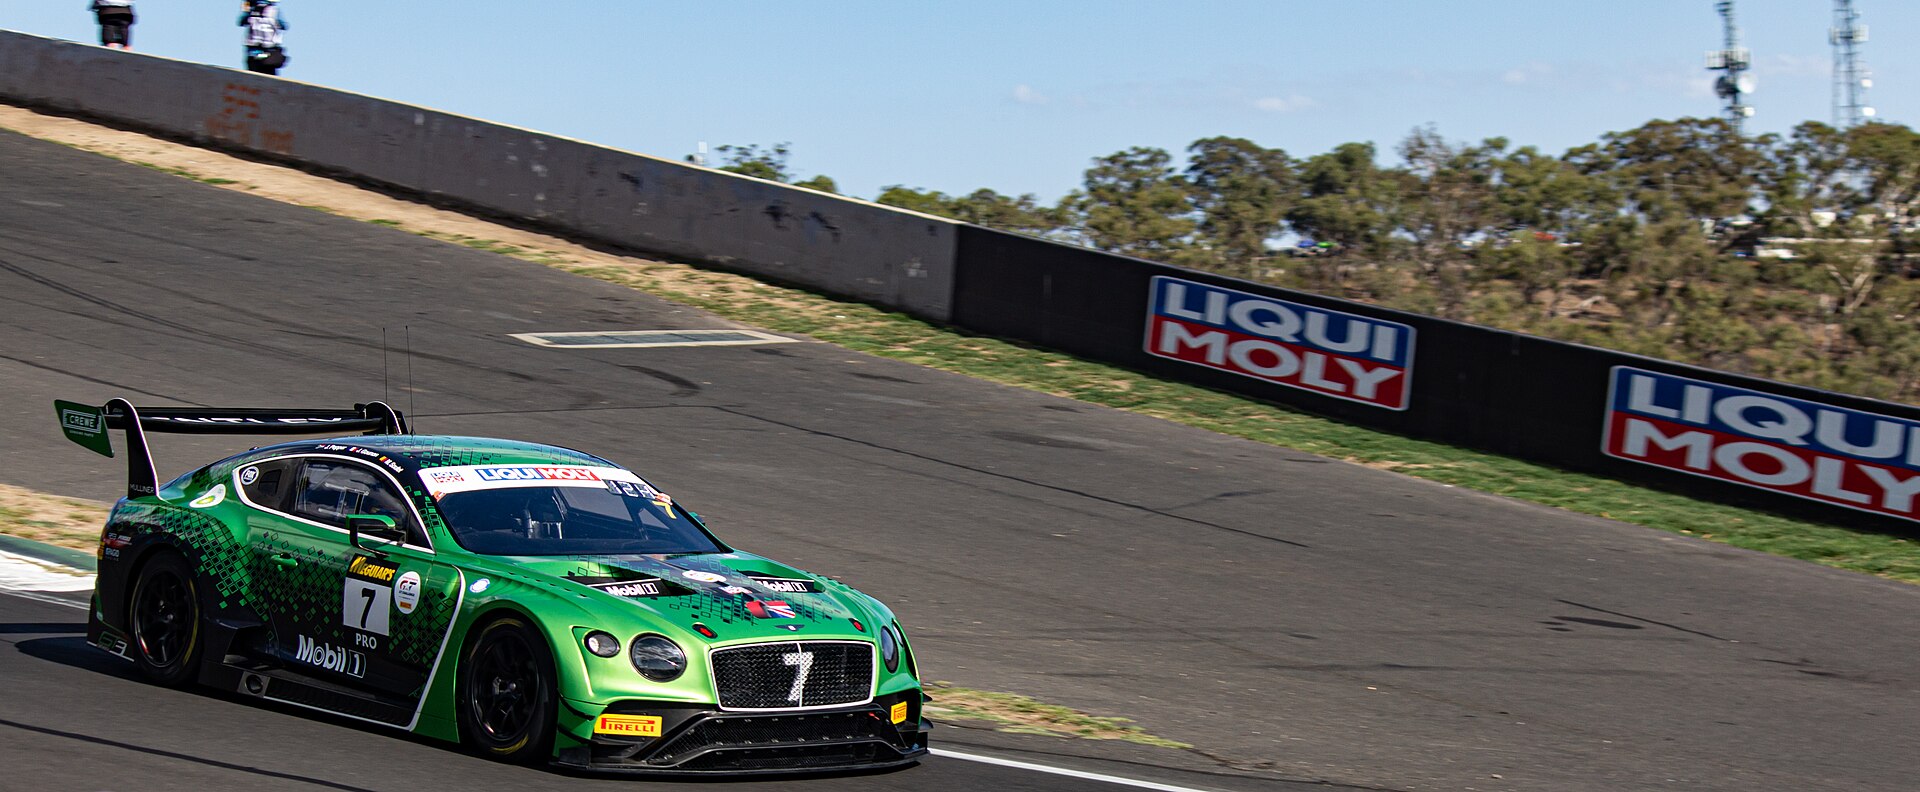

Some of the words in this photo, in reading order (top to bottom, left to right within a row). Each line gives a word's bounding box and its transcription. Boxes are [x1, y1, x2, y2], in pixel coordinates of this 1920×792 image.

[1163, 282, 1398, 361] LIQUI
[1159, 321, 1405, 399] MOLY
[70, 415, 95, 428] CREWE
[478, 468, 543, 480] LIQUI
[538, 468, 596, 480] MOLY
[1622, 418, 1920, 513] MOLY
[652, 500, 677, 519] 7
[605, 584, 646, 596] Mobil
[360, 587, 377, 629] 7
[295, 634, 347, 673] Mobil
[355, 632, 377, 650] PRO
[781, 651, 814, 701] 7
[601, 717, 656, 732] PIRELLI
